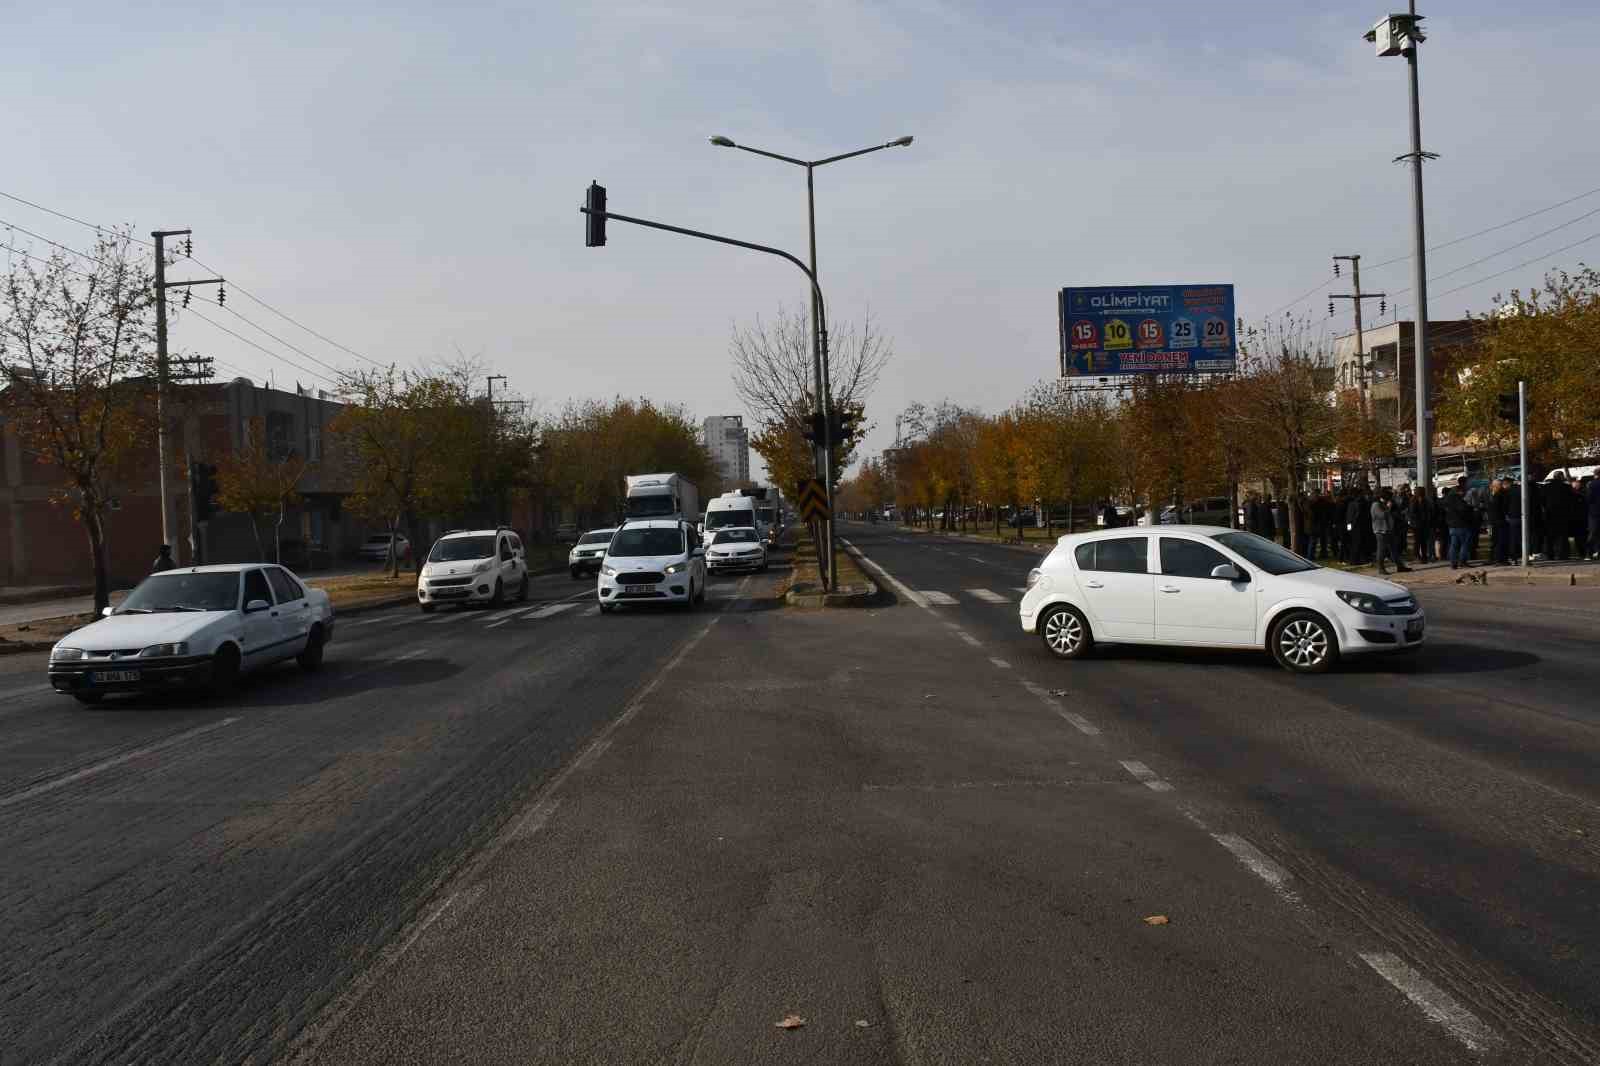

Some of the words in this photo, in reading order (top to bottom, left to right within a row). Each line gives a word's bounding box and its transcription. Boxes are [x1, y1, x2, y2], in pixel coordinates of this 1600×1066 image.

[1090, 292, 1169, 307] OLİMPİYAT
[1076, 324, 1092, 339] 15
[1110, 323, 1126, 338] 10
[1144, 323, 1158, 338] 15
[1175, 322, 1191, 337] 25
[1207, 321, 1224, 336] 20
